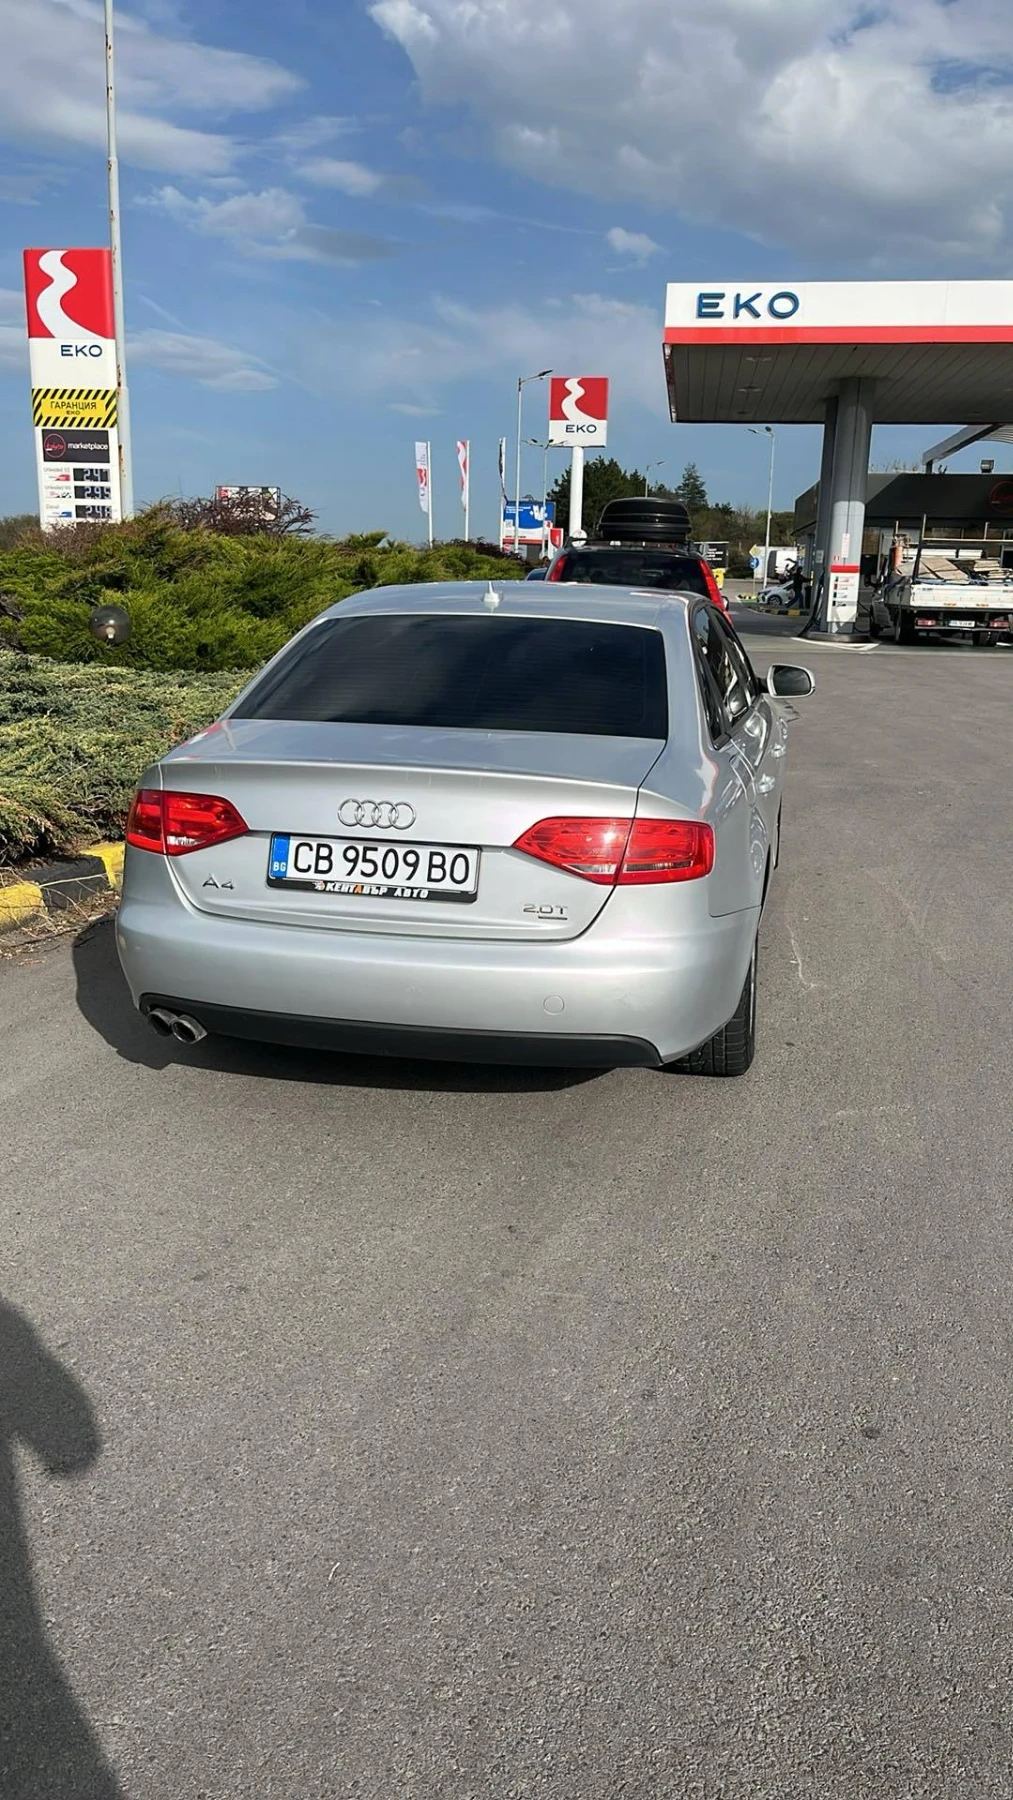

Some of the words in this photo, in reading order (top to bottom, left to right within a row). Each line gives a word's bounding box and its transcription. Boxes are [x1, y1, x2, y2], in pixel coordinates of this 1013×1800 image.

[696, 291, 799, 319] EKO
[60, 344, 103, 357] EKO
[50, 401, 97, 410] ГАРАНЦИЯ
[565, 424, 597, 434] EKO
[67, 442, 109, 451] marketplace
[273, 861, 287, 872] BG
[293, 842, 334, 874] CB
[342, 845, 421, 881] 9509
[426, 850, 470, 885] BO
[202, 873, 235, 890] A4
[325, 883, 388, 896] КЕНТАВЪР
[393, 888, 429, 899] АВТО
